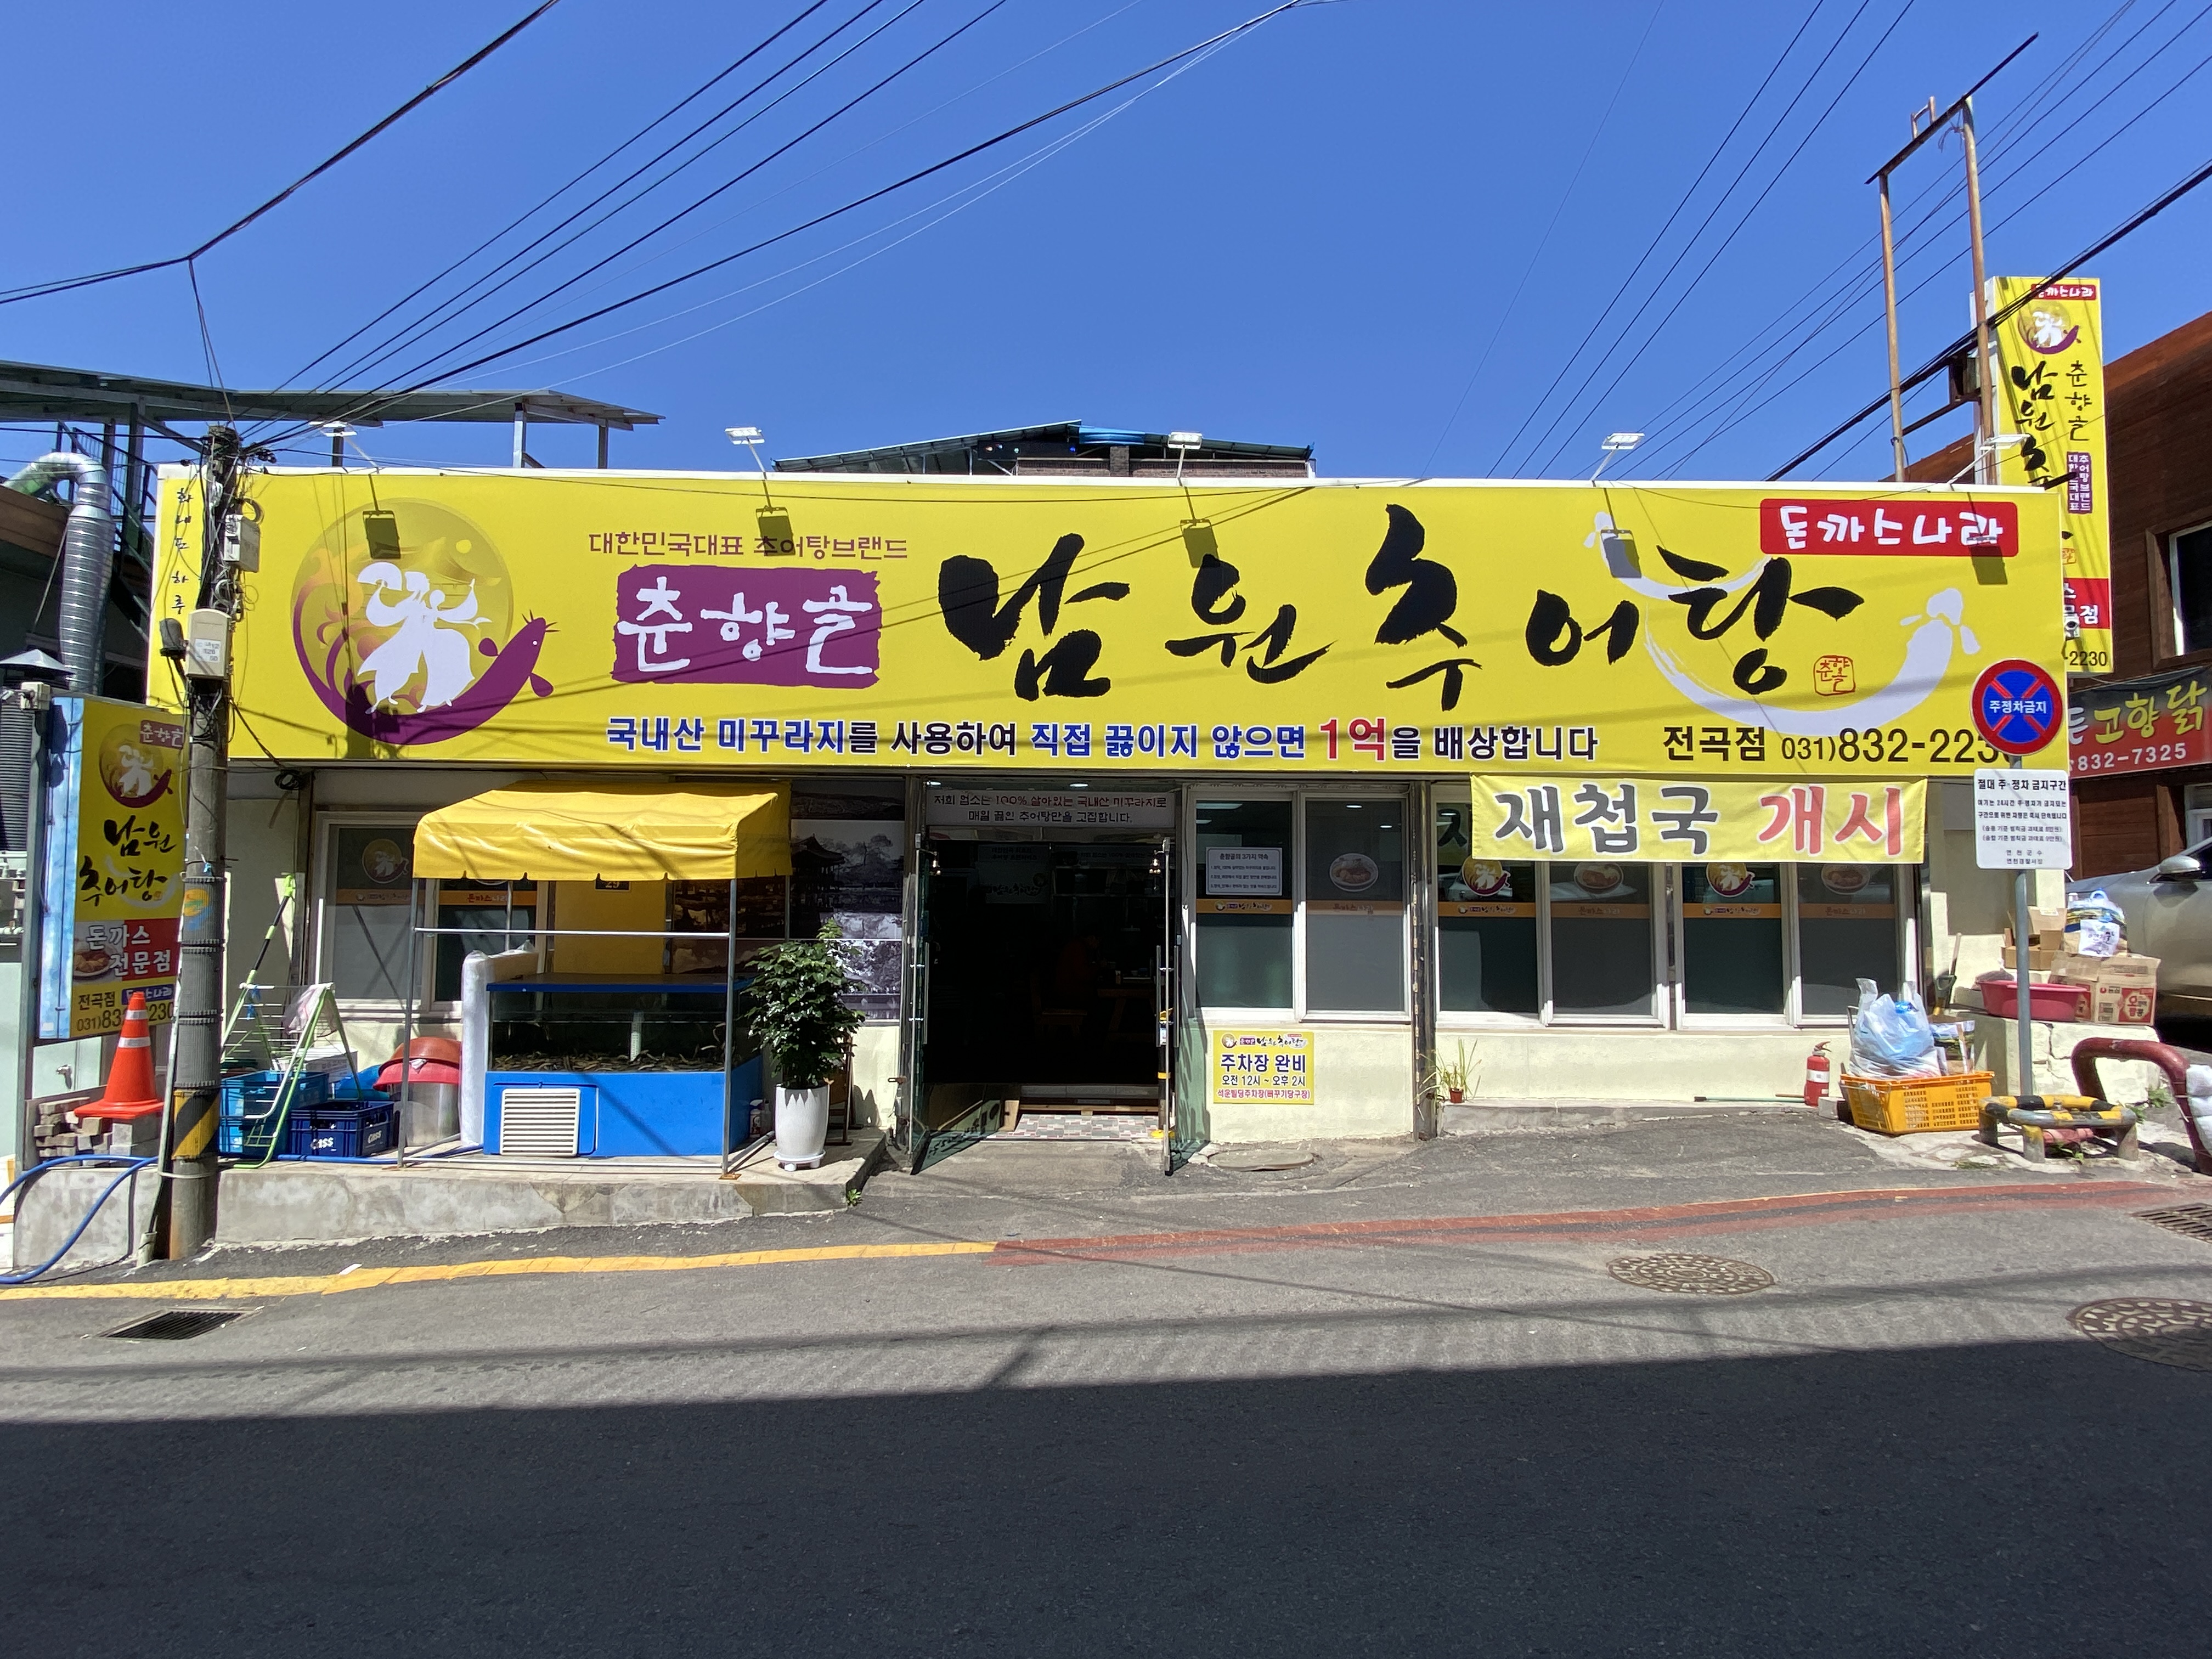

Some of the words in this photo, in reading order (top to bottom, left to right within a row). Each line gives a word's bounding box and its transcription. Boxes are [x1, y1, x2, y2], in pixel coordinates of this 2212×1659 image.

[2064, 360, 2092, 441] 춘향골
[2068, 455, 2080, 511] 대한국대표
[2079, 455, 2091, 511] 추어탕브랜드
[589, 532, 744, 557] 대한민국대표
[753, 535, 908, 560] 추어탕브랜드
[1780, 506, 2004, 550] 돈까스나라
[617, 576, 873, 674] 춘향골
[938, 503, 1865, 712] 남원추어탕
[1989, 700, 2046, 714] 주정차금지
[606, 718, 704, 751] 국내산
[719, 718, 878, 753] 미꾸라지를
[890, 721, 1016, 755] 사용하여
[1031, 724, 1091, 756] 직접
[1105, 725, 1198, 758] 끓이지
[1212, 726, 1305, 759] 않으면
[1319, 718, 1422, 761] 1억을
[1434, 726, 1598, 760] 배상합니다
[1663, 726, 1765, 761] 전곡점
[1781, 728, 2010, 763] 031)832-223
[934, 795, 955, 805] 저희
[960, 795, 991, 806] 업소는
[995, 796, 1026, 806] 100%
[1031, 796, 1073, 807] 살아있는
[1077, 797, 1109, 807] 국내산
[1113, 797, 1167, 808] 미꾸라지로
[1978, 779, 1995, 789] 절대
[2032, 780, 2067, 791] 금지구간
[968, 811, 989, 821] 매일
[994, 811, 1014, 821] 끓인
[1019, 811, 1072, 822] 추어탕만을
[1495, 784, 1718, 855] 재첩국
[1759, 787, 1901, 856] 개시
[104, 815, 177, 857] 남원
[80, 856, 167, 906] 추어탕
[86, 925, 151, 950] 돈까스
[109, 950, 171, 977] 전문점
[78, 991, 115, 1011] 전곡점
[1221, 1054, 1269, 1072] 주차장
[1275, 1055, 1305, 1073] 완비
[1222, 1075, 1238, 1086] 오전
[1242, 1075, 1260, 1086] 12시
[1273, 1075, 1288, 1086] 오후
[1292, 1076, 1305, 1086] 2시
